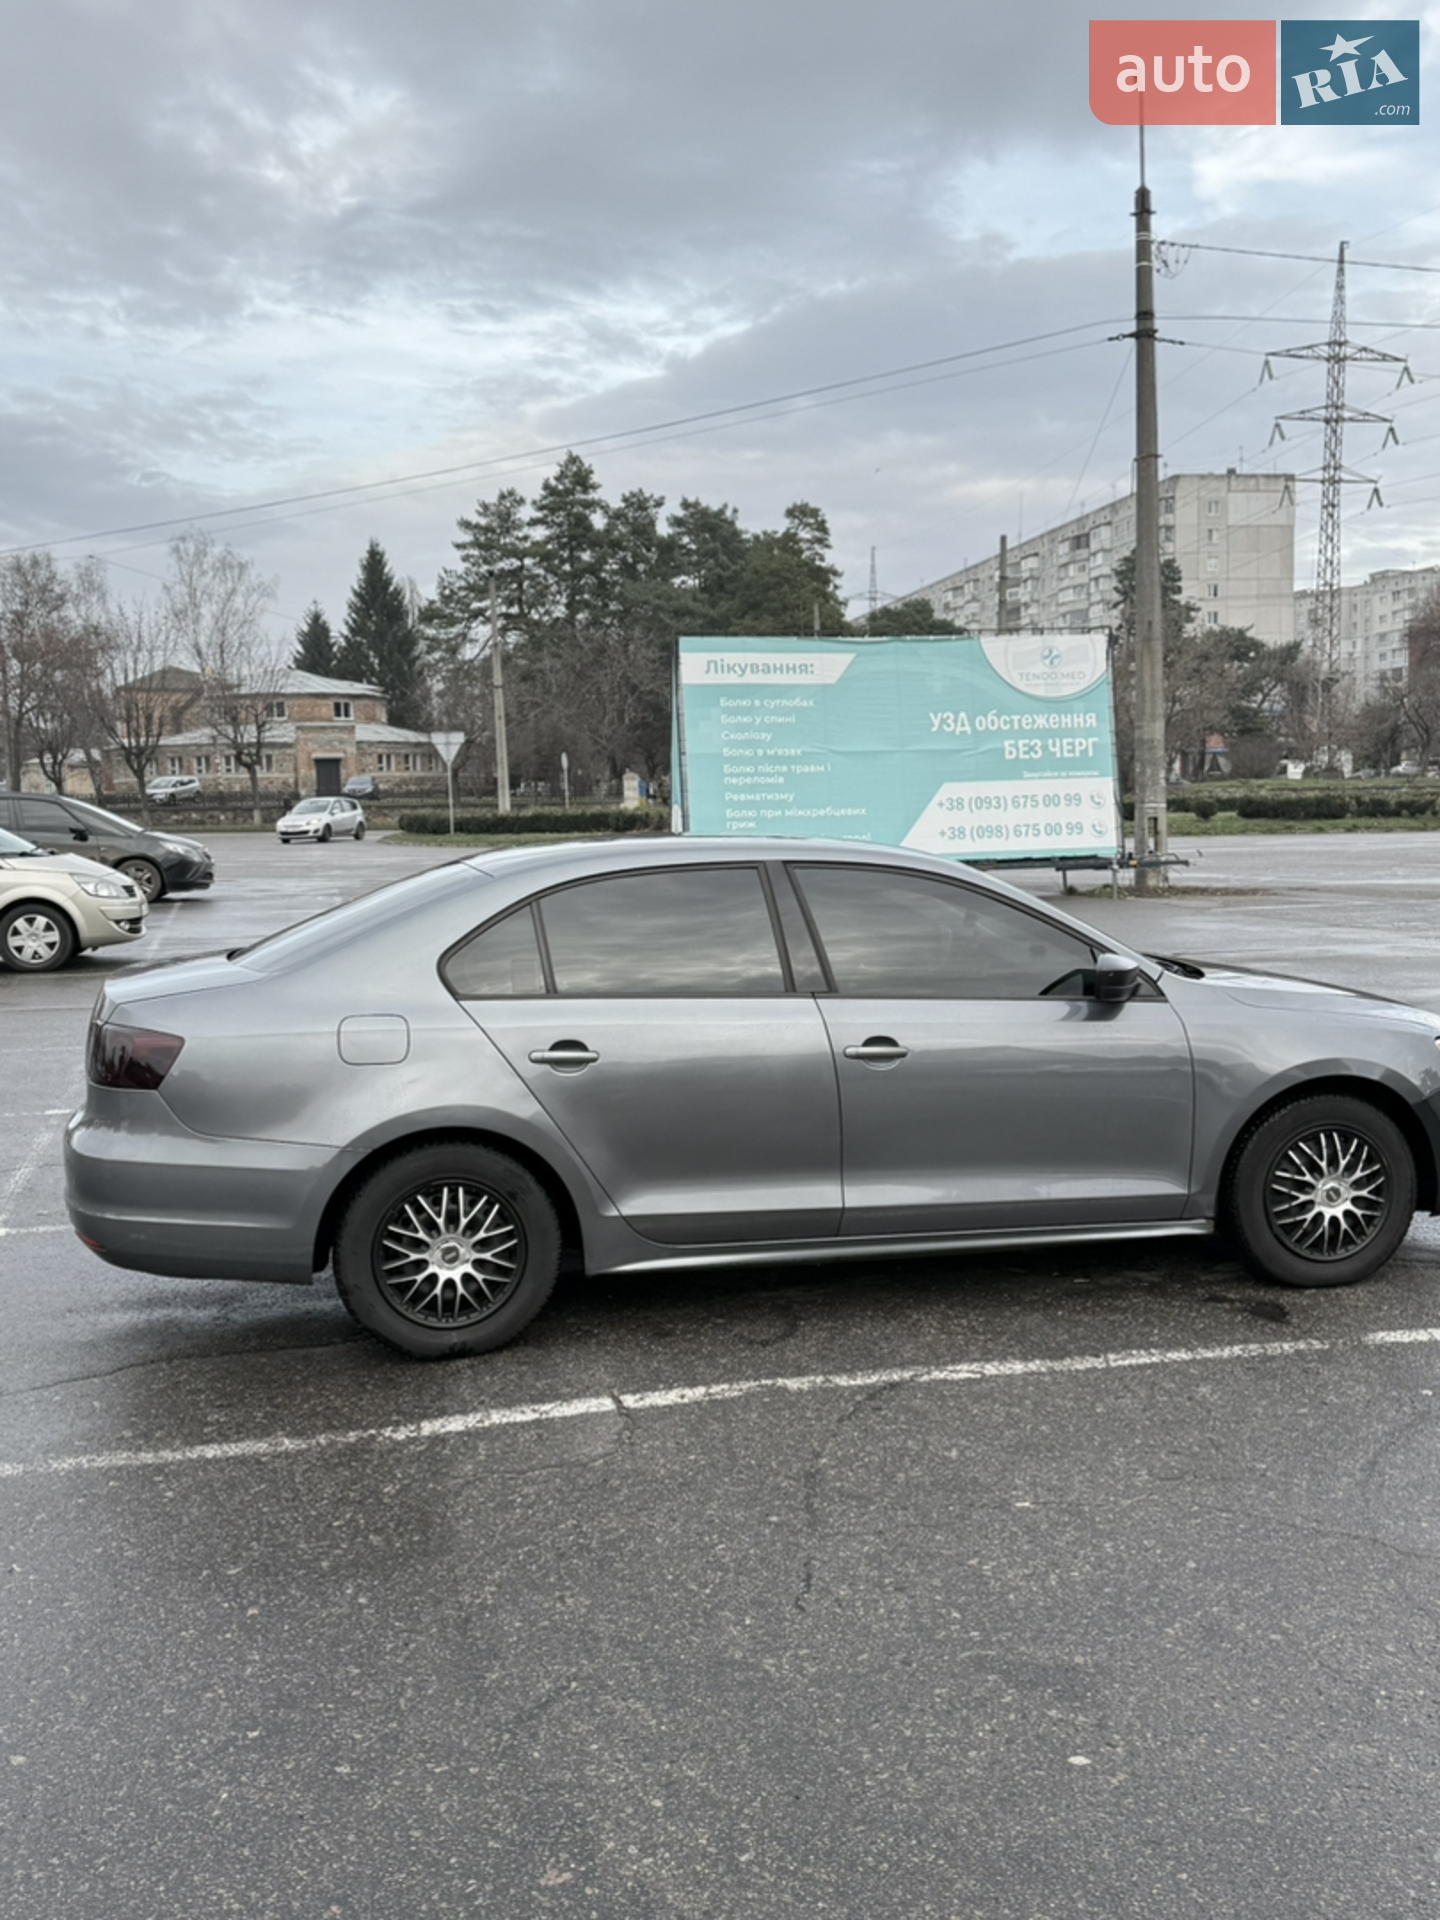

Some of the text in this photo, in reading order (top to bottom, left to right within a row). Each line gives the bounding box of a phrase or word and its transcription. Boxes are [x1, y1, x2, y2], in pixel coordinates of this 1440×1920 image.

[705, 658, 815, 678] Лікування:
[1018, 670, 1086, 681] TENDO MED
[719, 697, 751, 707] Болю
[763, 697, 815, 709] суглобах
[721, 713, 796, 726] Болю у спині
[929, 709, 1097, 735] УЗД обстеження
[721, 730, 772, 742] Сколіозу
[723, 747, 754, 757] Болю
[1004, 737, 1099, 760] БЕЗ ЧЕРГ
[723, 764, 755, 774] Болю
[757, 762, 788, 774] після
[790, 763, 825, 774] травм
[724, 774, 785, 786] переломів
[725, 791, 795, 803] Ревматизму
[937, 793, 1082, 813] +38 (093) 675 00 99
[726, 808, 758, 818] Болю
[760, 809, 782, 818] при
[726, 821, 757, 830] гриж
[938, 821, 1084, 842] +38 (098) 675 00 99
